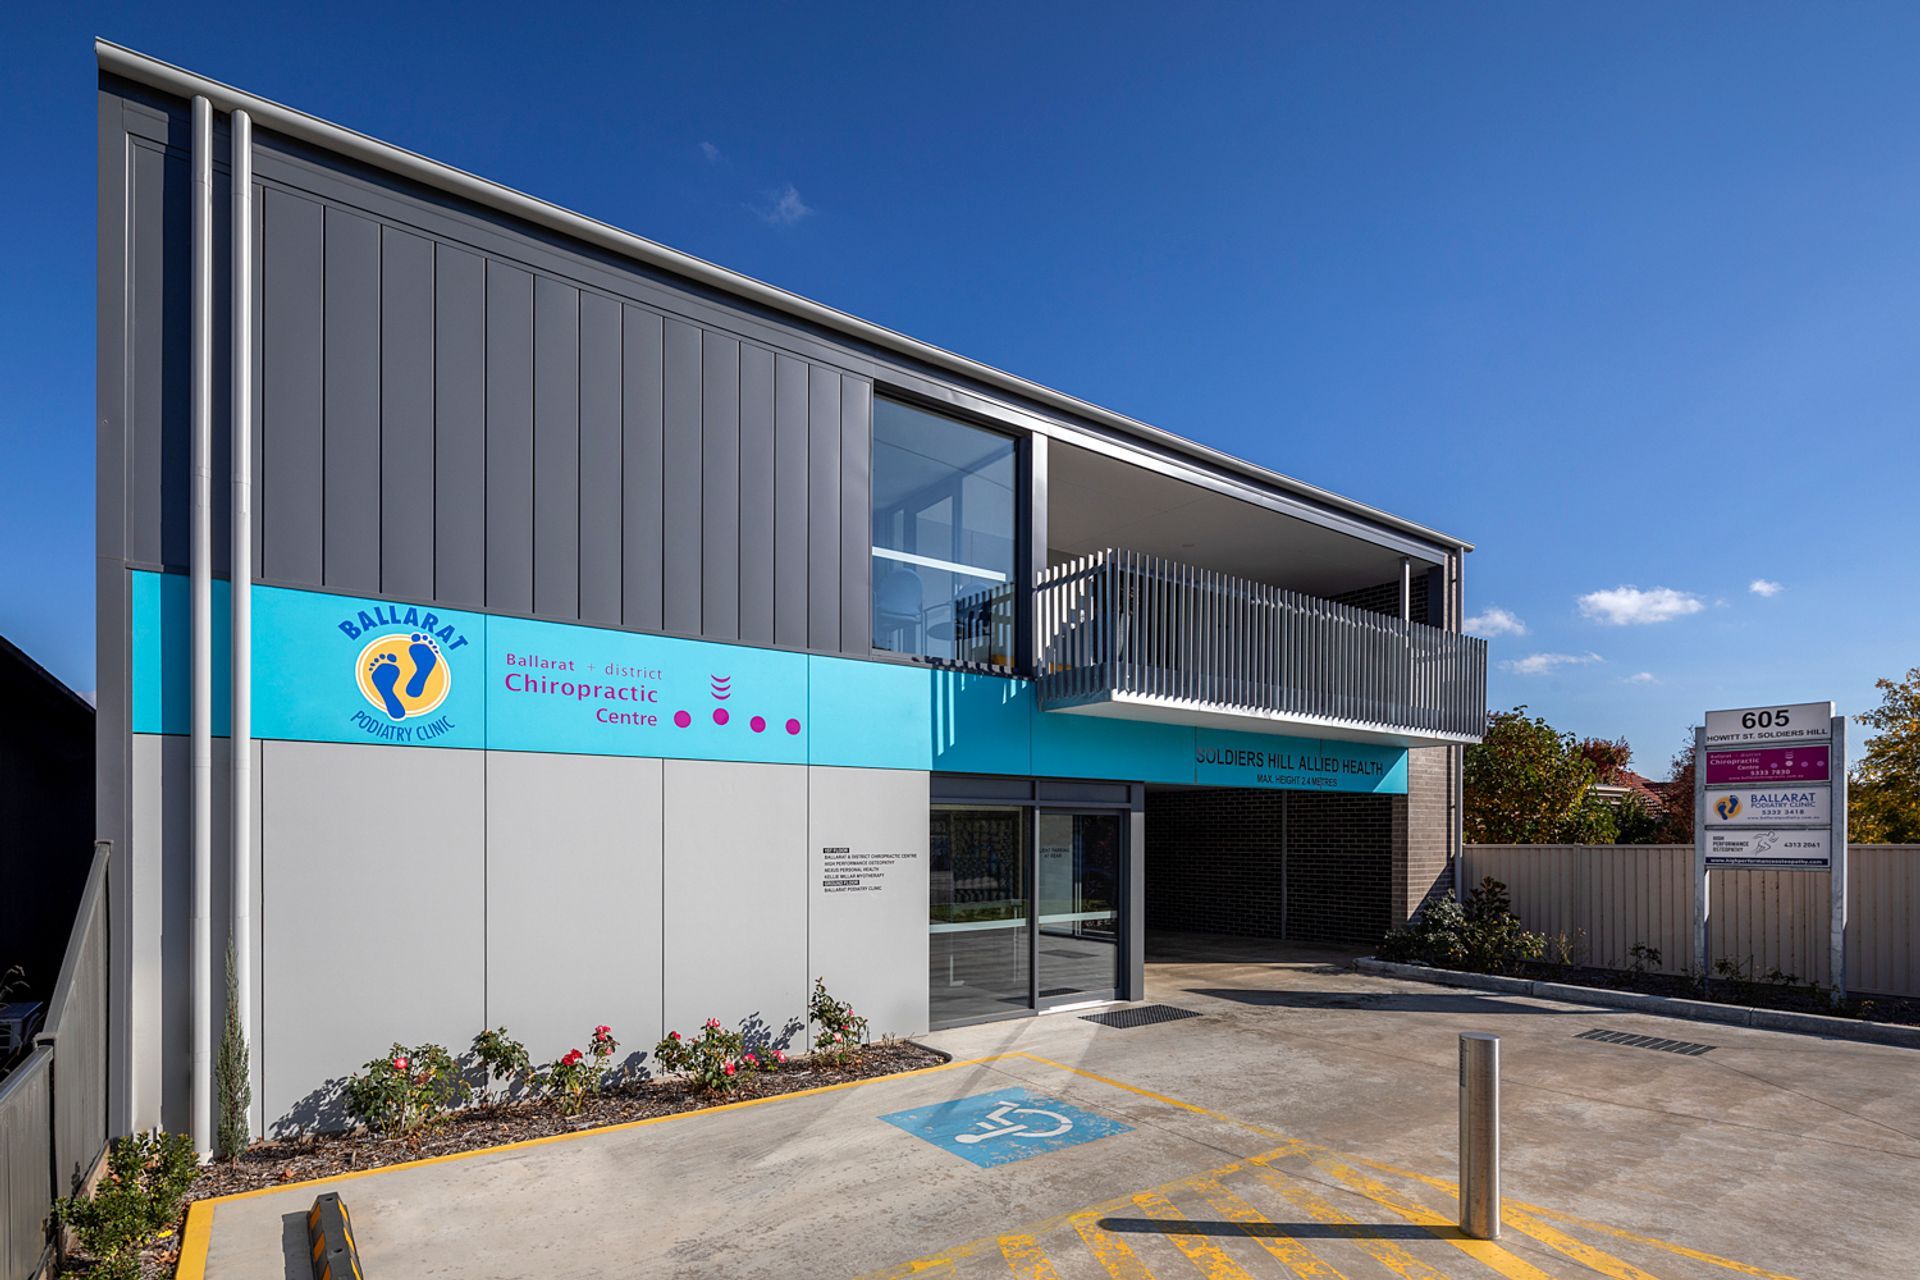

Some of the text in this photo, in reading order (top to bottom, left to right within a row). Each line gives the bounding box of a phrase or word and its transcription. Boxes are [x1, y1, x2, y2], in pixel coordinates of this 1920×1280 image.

[338, 605, 469, 651] BALLARAT
[506, 653, 575, 672] Ballarat
[605, 663, 662, 681] district
[505, 673, 658, 703] Chiropractic
[350, 710, 456, 742] PODIATRY CLINIC
[596, 708, 657, 727] Centre
[1741, 709, 1790, 729] 605
[1706, 734, 1740, 742] HOWITT
[1757, 729, 1804, 739] SOLDIERS
[1196, 747, 1383, 775] SOLDIERS HILL ALLIED HEALTH
[1710, 758, 1760, 766] Chiropractic
[1276, 775, 1300, 784] HEIGHT
[1312, 777, 1337, 787] METRES
[1750, 792, 1816, 803] BALLARAT
